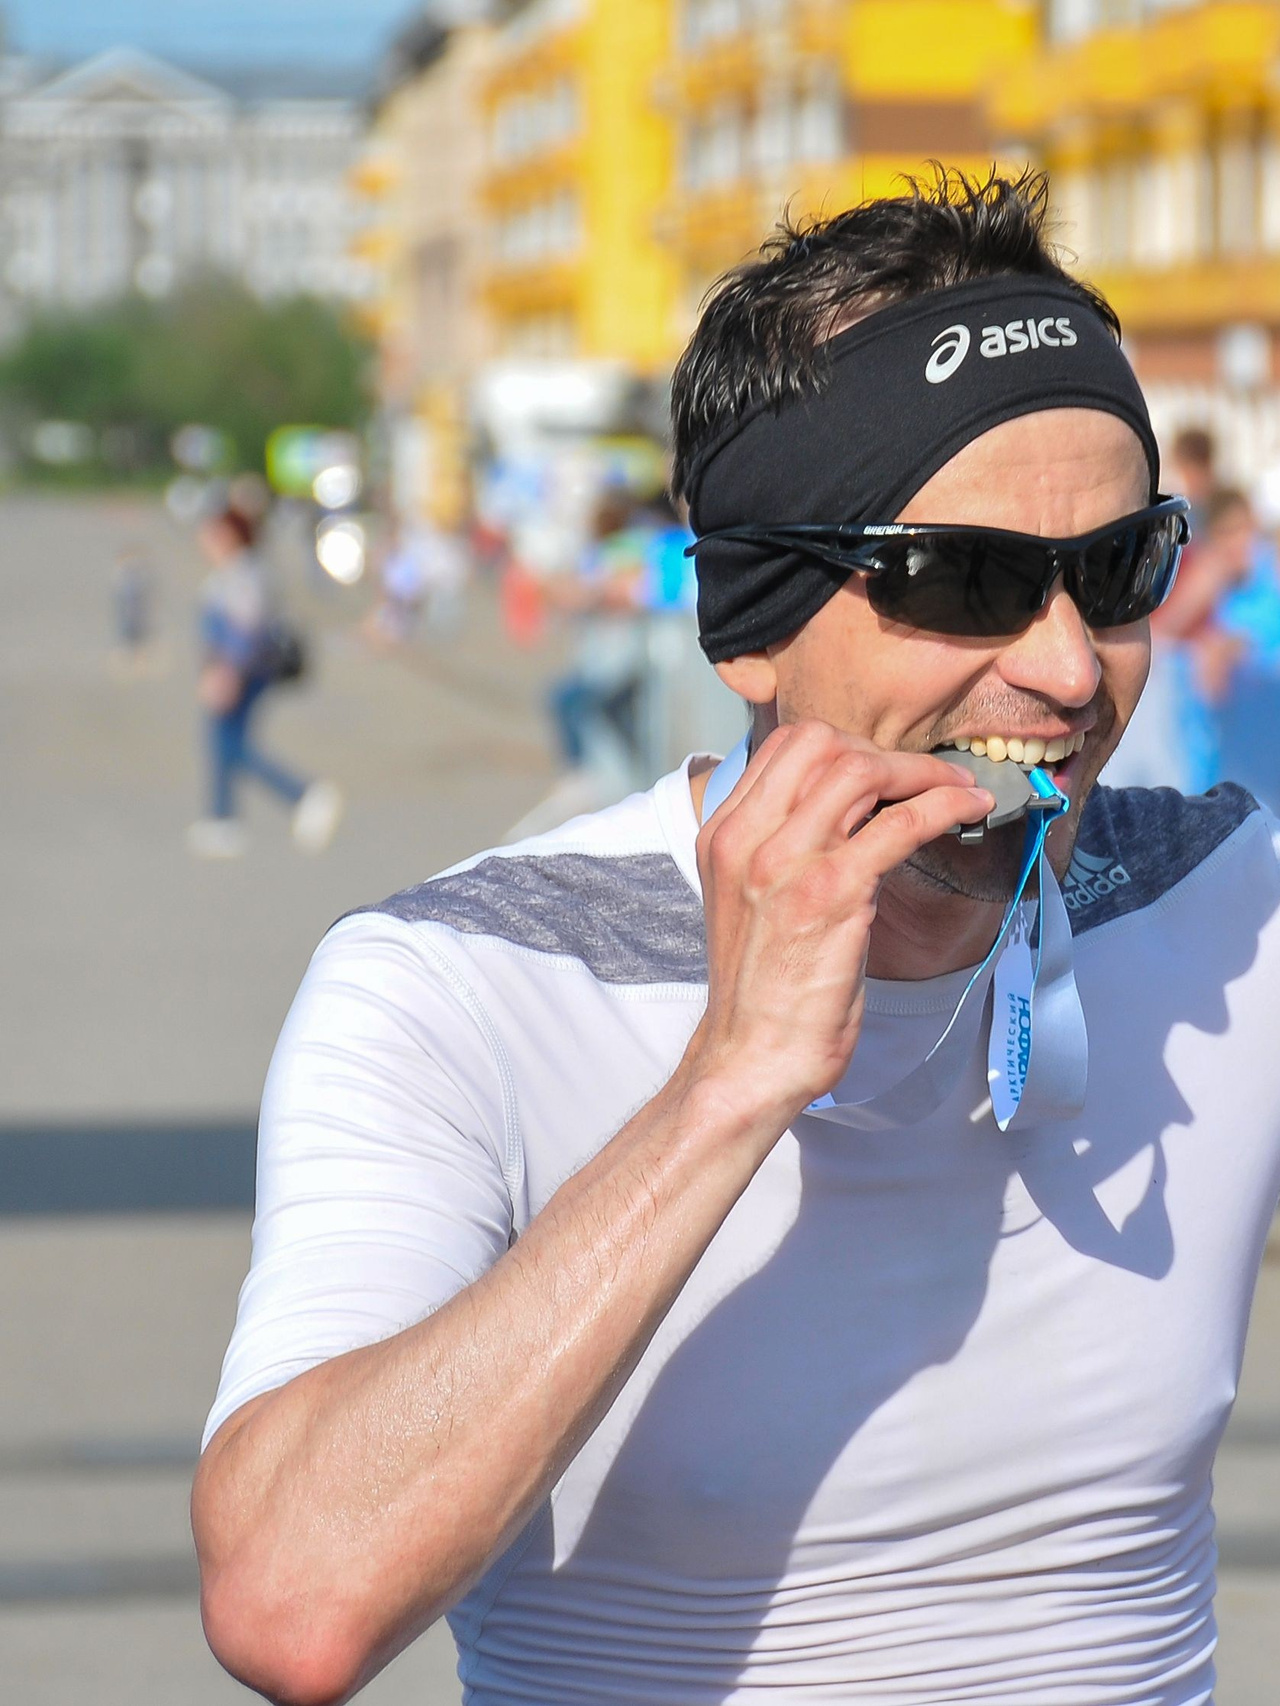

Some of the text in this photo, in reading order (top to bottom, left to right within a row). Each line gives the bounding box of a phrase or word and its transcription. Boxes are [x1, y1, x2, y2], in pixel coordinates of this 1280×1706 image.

[979, 316, 1078, 359] asics
[1062, 863, 1132, 911] adida
[1006, 993, 1020, 1103] АРКТИЧЕСКИЙ
[1017, 996, 1032, 1092] РАФОН
